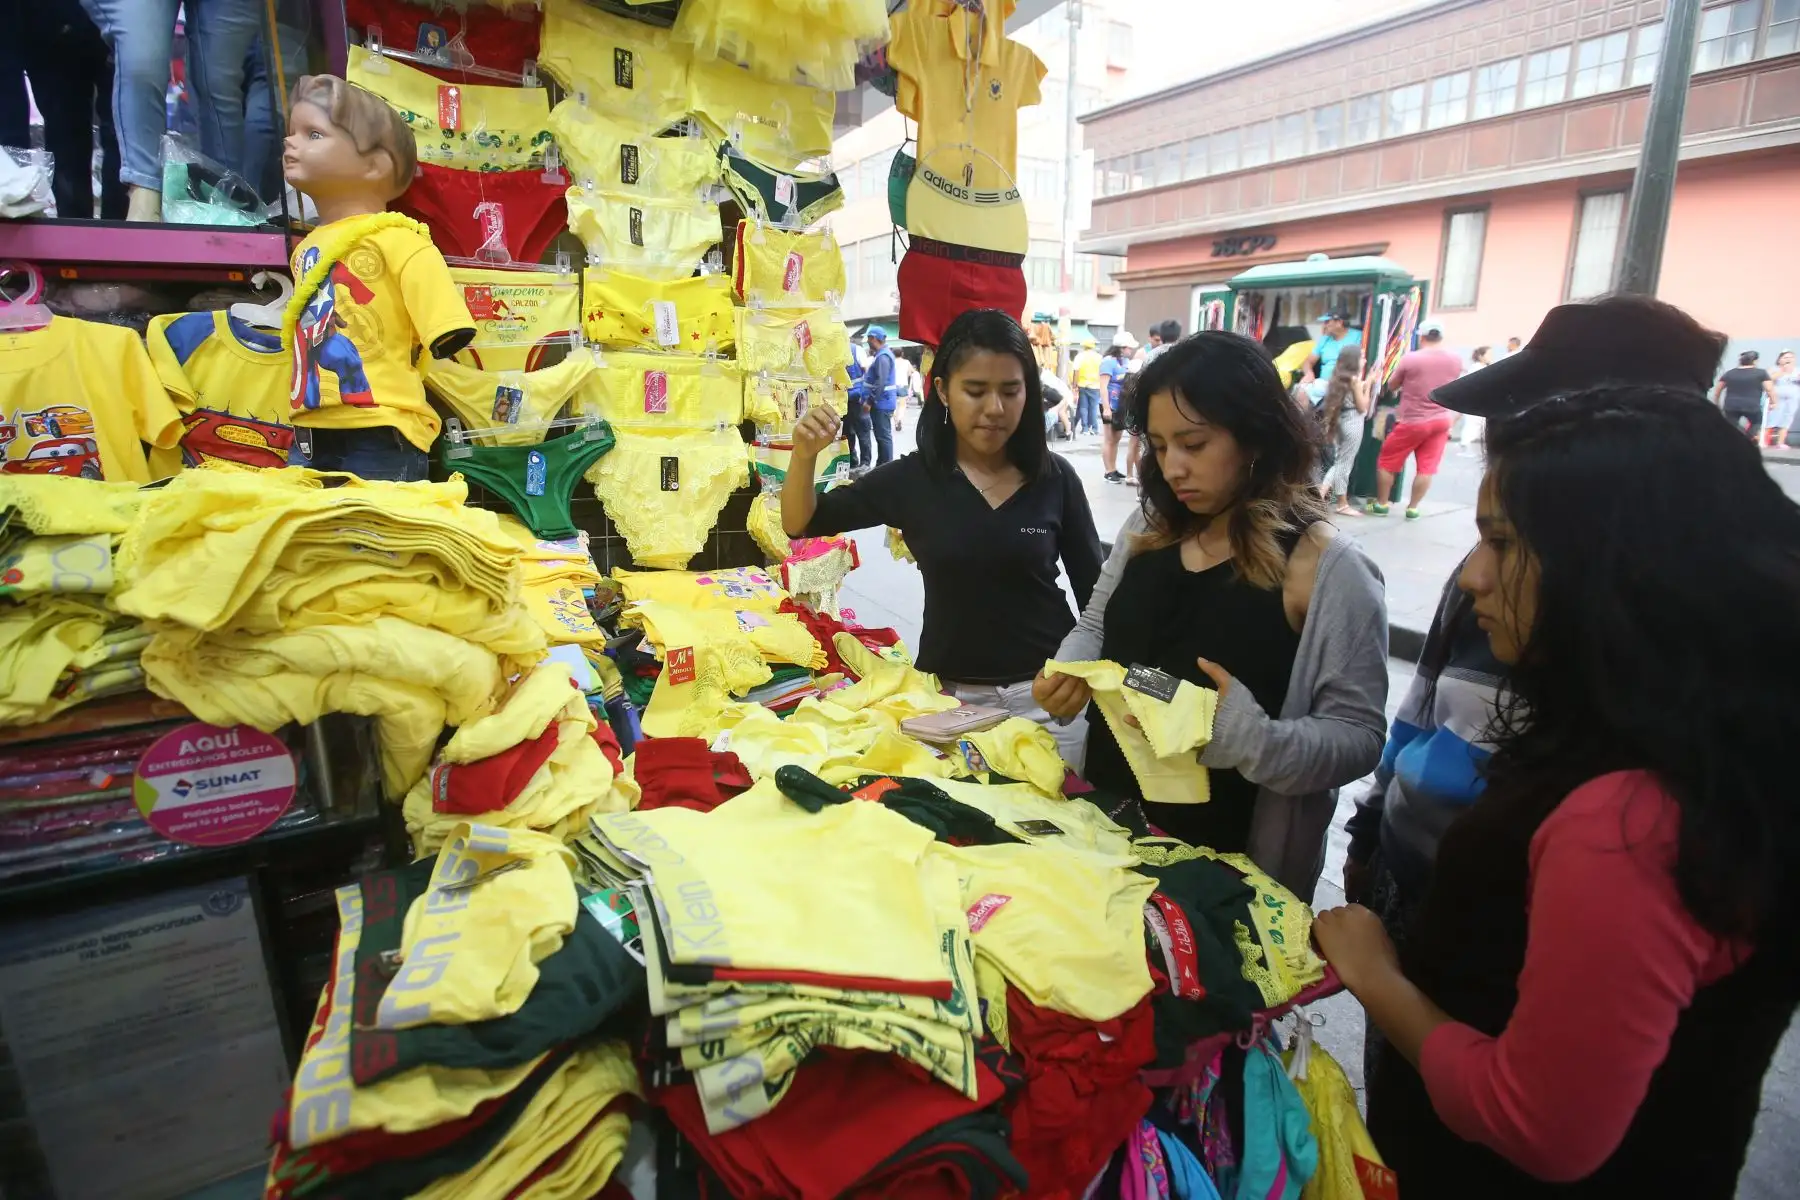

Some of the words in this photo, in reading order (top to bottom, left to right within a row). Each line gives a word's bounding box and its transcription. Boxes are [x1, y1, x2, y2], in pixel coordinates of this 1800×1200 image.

[923, 169, 969, 200] adidas
[178, 729, 240, 756] AQUÍ
[148, 752, 228, 772] ENTREGAMOS
[229, 744, 273, 759] BOLETA
[195, 769, 262, 790] SUNAT
[674, 879, 725, 951] Klein
